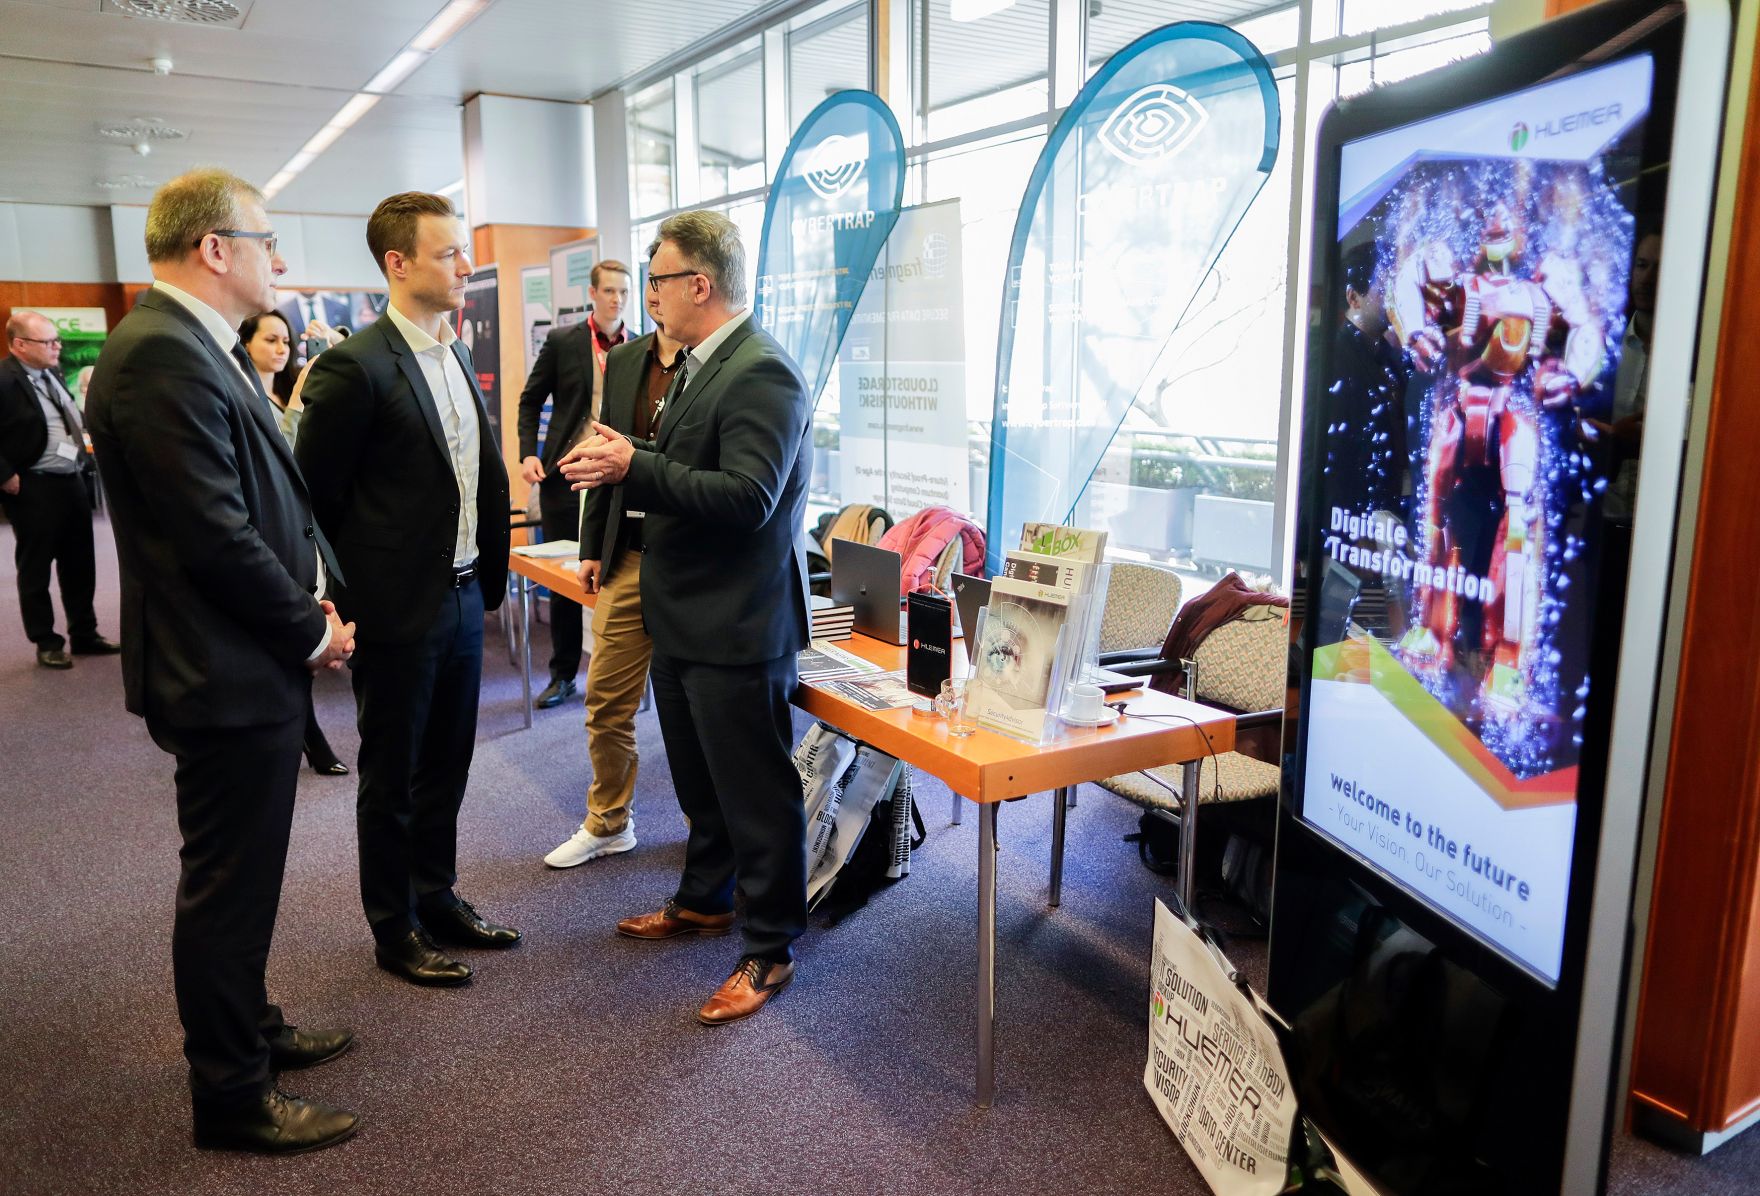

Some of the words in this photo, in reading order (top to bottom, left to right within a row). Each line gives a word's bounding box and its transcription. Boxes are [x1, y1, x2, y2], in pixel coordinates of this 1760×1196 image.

[1535, 103, 1622, 139] HUEMER
[1331, 506, 1409, 547] Digitale
[1328, 535, 1496, 605] Transformation
[910, 642, 946, 655] HUEMER
[1331, 772, 1401, 826] welcome
[1406, 811, 1422, 839] to
[1427, 824, 1457, 860] the
[1463, 843, 1530, 902] future
[1337, 802, 1364, 832] Your
[1368, 824, 1410, 864] Vision.
[1415, 851, 1442, 881] Our
[1446, 870, 1513, 927] Solution
[1166, 967, 1209, 1016] SOLUTION
[1165, 1004, 1262, 1121] HUEMER
[1212, 1022, 1248, 1070] SERVICE
[1178, 1081, 1201, 1145] BLOCKCHAIN
[1198, 1104, 1217, 1140] DATA
[1214, 1129, 1257, 1175] CENTER
